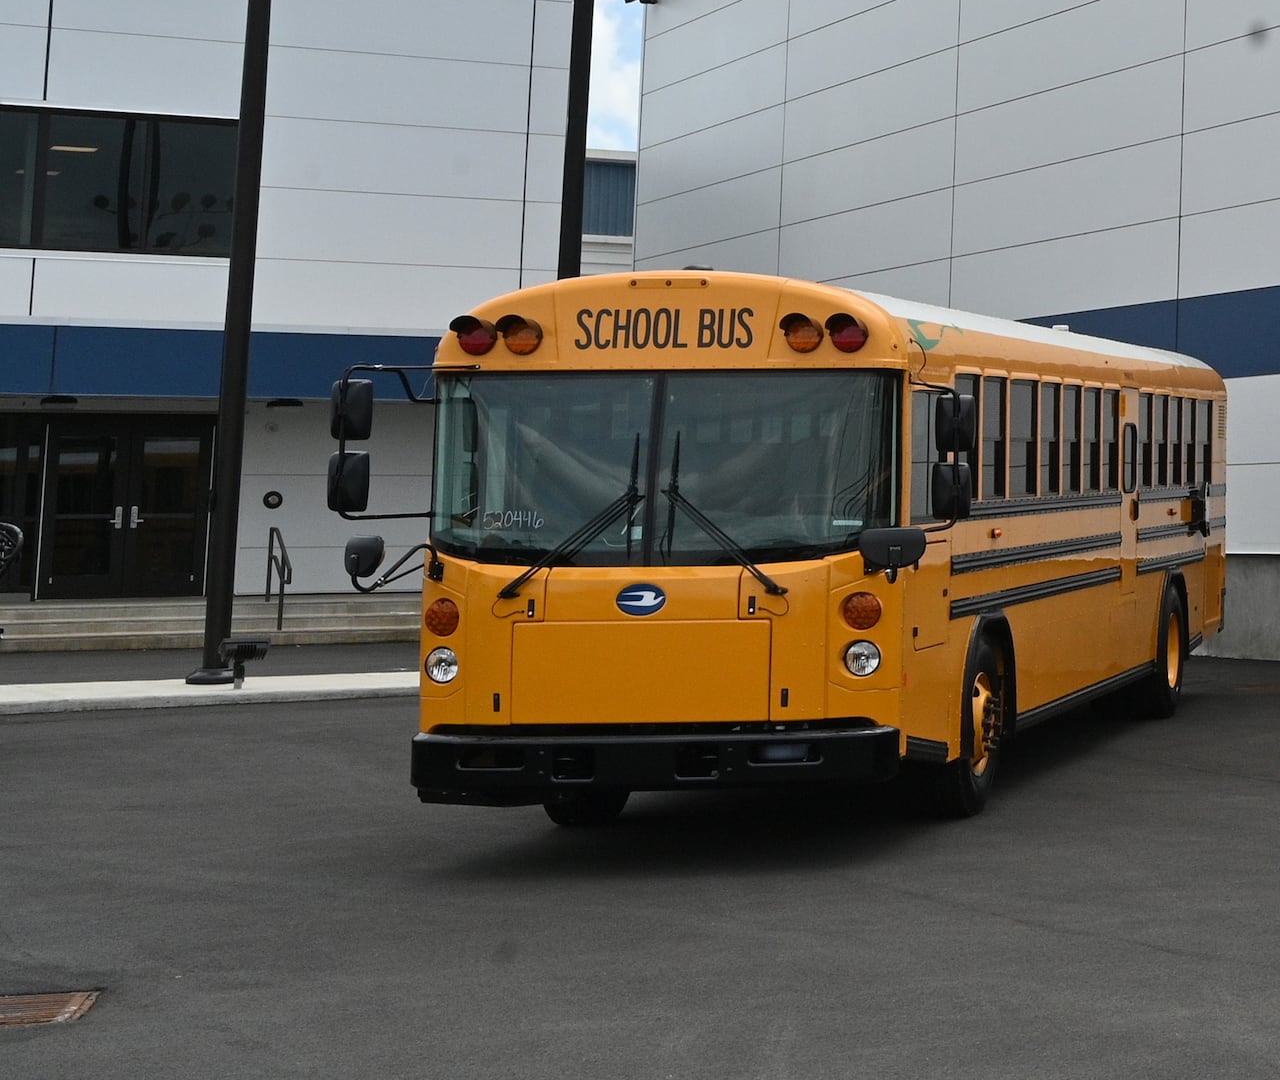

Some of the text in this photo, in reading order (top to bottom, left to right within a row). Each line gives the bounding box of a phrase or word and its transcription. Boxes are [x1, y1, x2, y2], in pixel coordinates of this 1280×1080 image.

[574, 307, 754, 350] SCHOOL BUS
[483, 510, 544, 530] 520446
